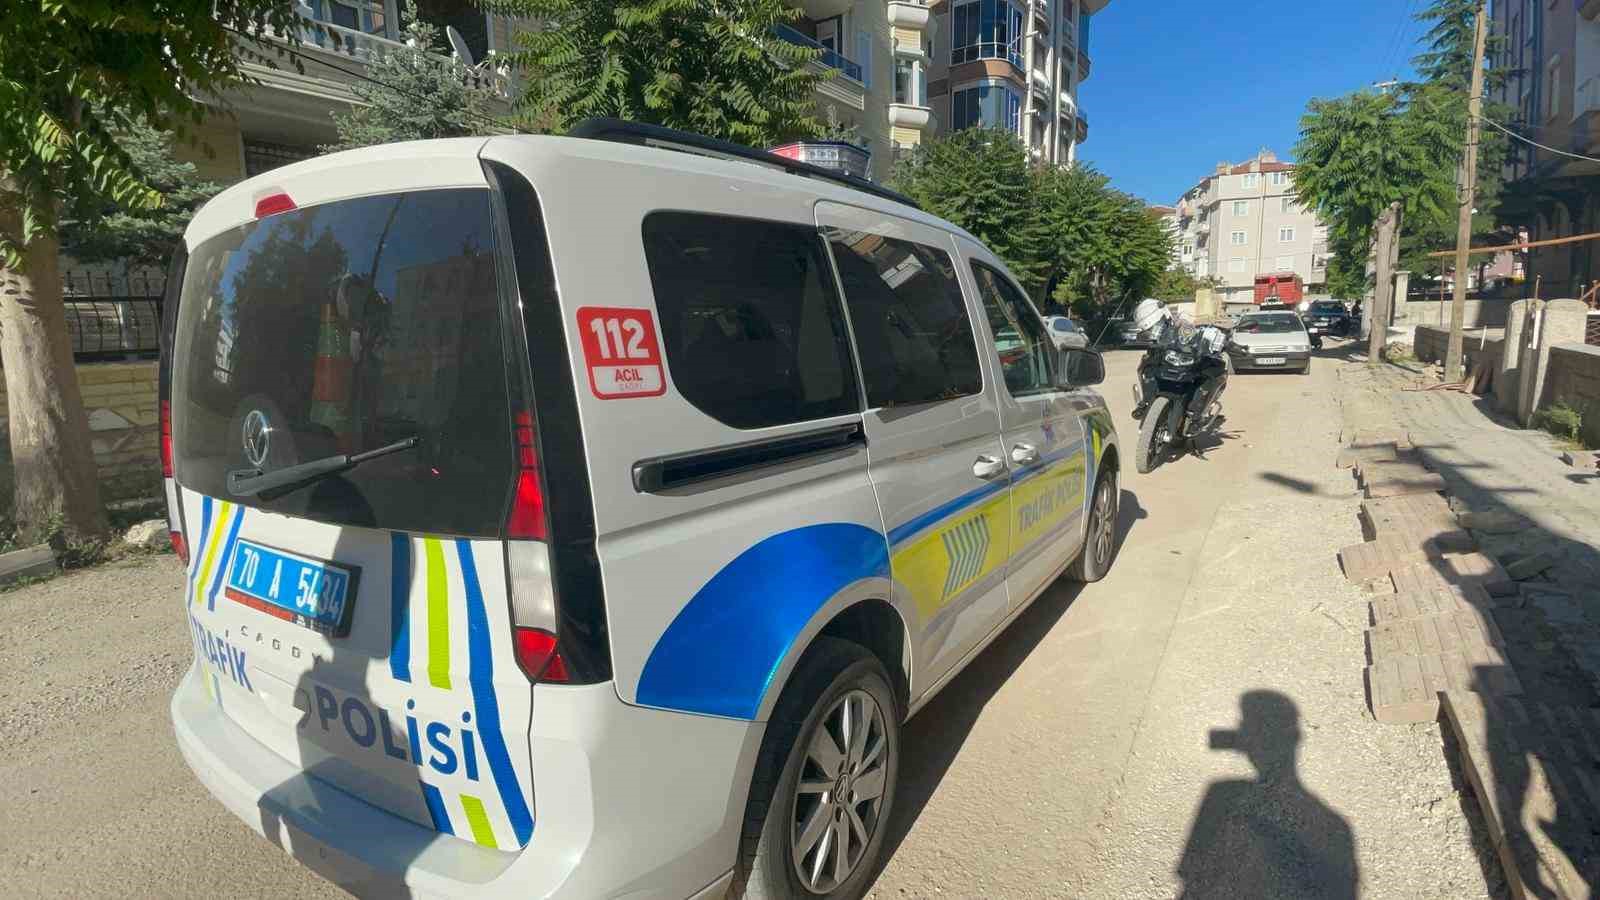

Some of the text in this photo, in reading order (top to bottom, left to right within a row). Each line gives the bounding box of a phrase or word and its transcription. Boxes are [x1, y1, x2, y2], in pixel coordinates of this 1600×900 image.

[590, 318, 650, 359] 112
[238, 548, 341, 620] 70 A 5434
[314, 685, 479, 781] POLİSİ
